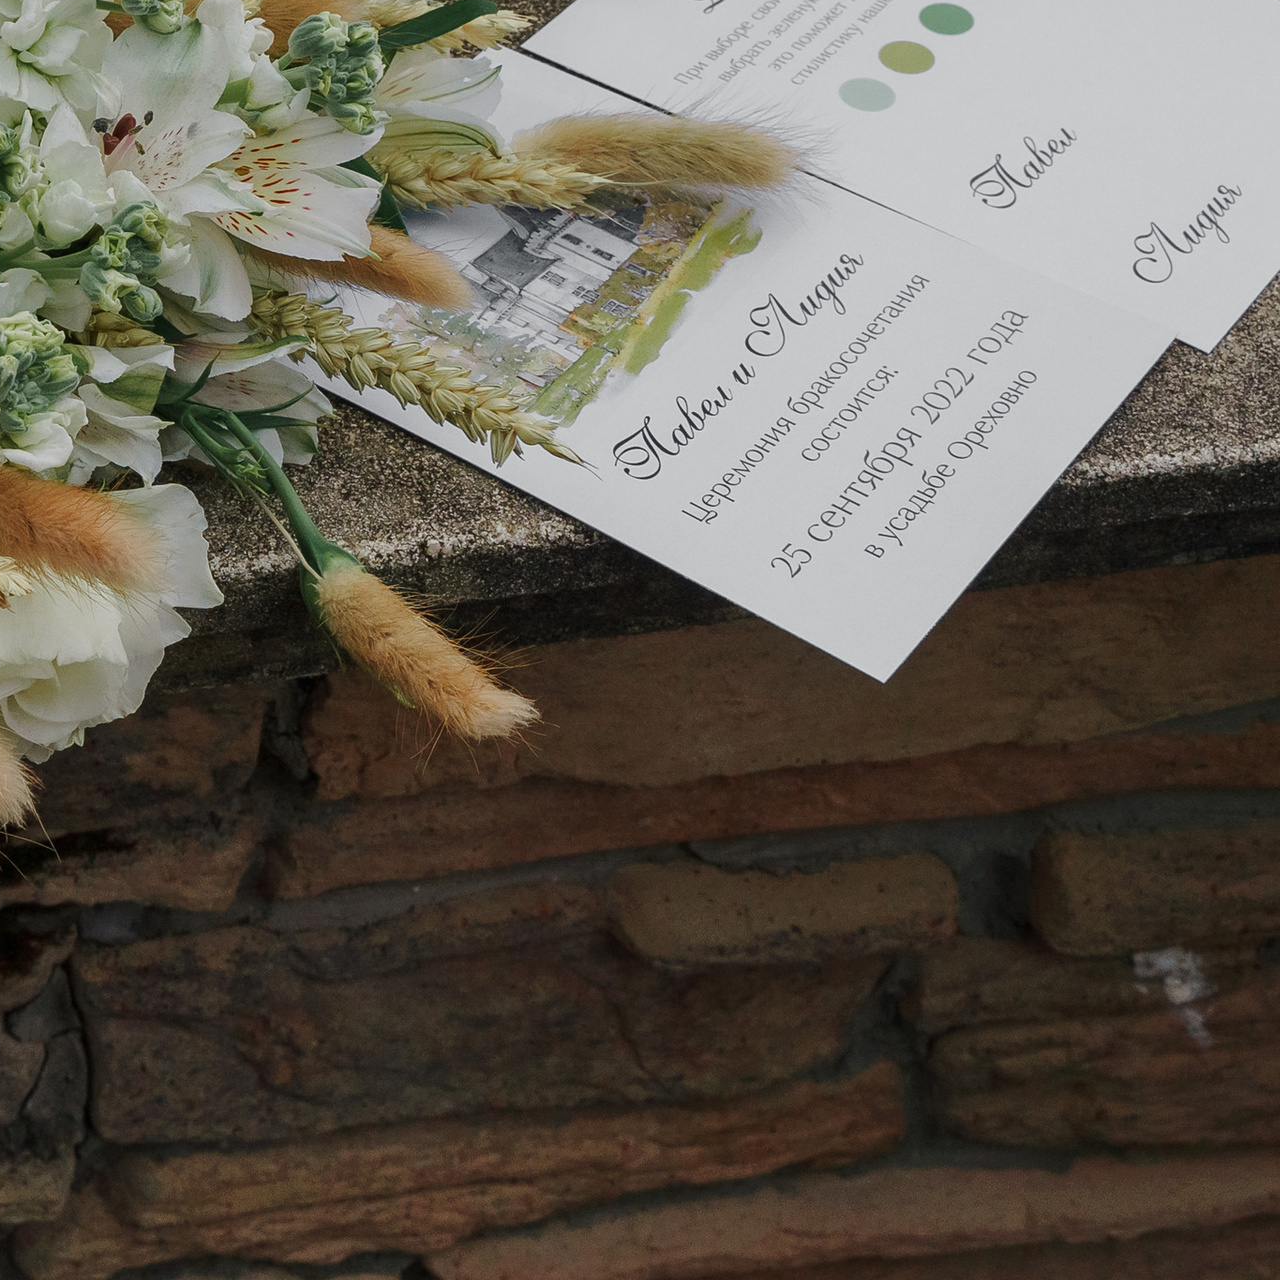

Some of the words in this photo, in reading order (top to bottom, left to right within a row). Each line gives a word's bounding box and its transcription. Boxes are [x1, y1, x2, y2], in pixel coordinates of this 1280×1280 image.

[673, 61, 709, 86] При
[704, 20, 755, 62] выборе
[717, 39, 773, 84] выбрать
[767, 51, 795, 72] это
[790, 1, 848, 52] поможет
[790, 23, 864, 86] стилистику
[969, 127, 1077, 209] Павел
[1132, 184, 1243, 284] Лидия
[612, 385, 734, 481] Павел
[732, 362, 756, 386] и
[744, 253, 864, 357] Лидия
[681, 416, 797, 525] Церемония
[786, 274, 931, 415] бракосочетания
[801, 365, 899, 462] состоится:
[770, 542, 813, 579] 25
[807, 427, 923, 542] сентября
[910, 367, 975, 426] 2022
[966, 310, 1030, 366] года
[862, 543, 886, 560] в
[877, 463, 956, 547] усадьбе
[947, 370, 1038, 460] Ореховно
